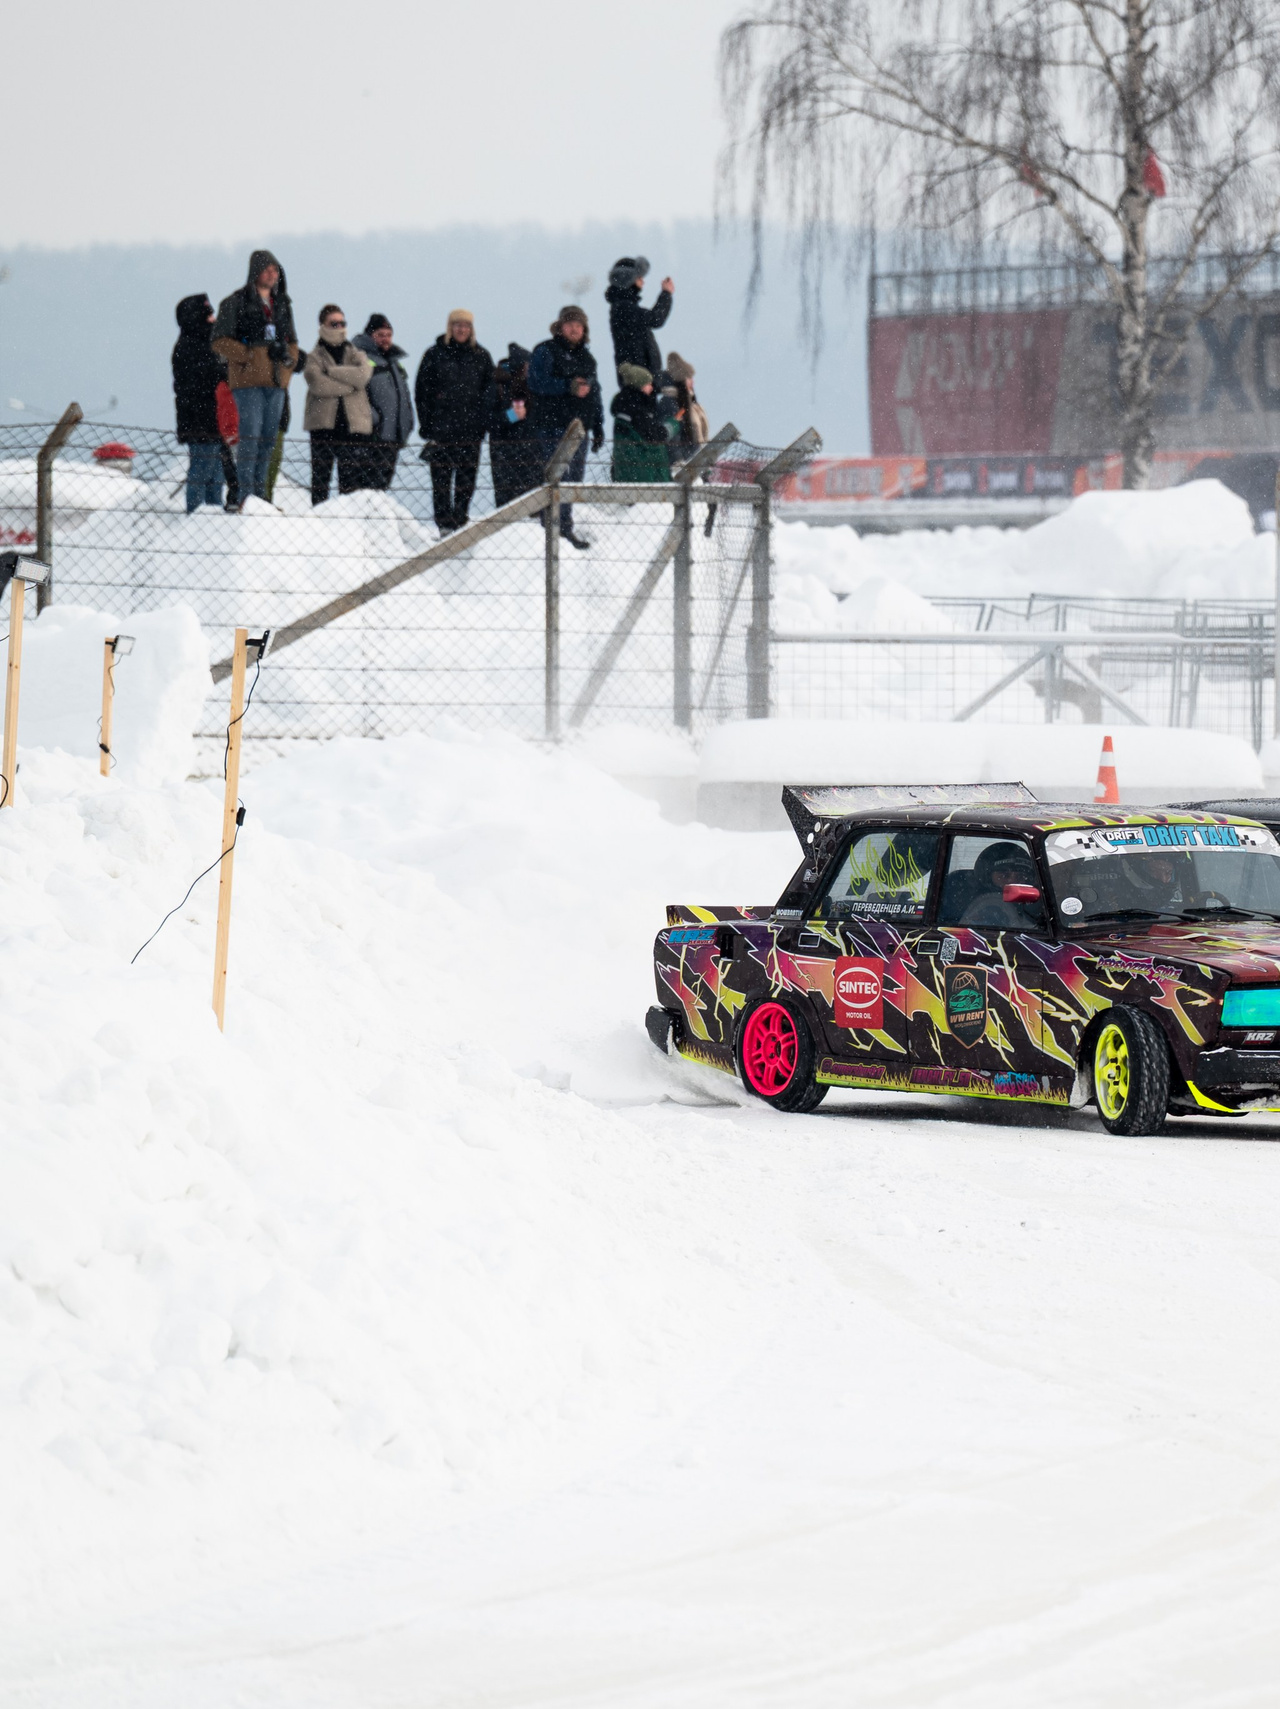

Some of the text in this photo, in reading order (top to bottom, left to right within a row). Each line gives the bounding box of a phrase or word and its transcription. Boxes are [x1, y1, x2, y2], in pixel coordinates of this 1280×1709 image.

[1106, 831, 1140, 841] DRIFT
[1143, 826, 1241, 847] DRIFT TAXI
[852, 902, 901, 914] ПЕРЕВЕДЕНЦЕВ
[839, 981, 878, 995] SINTEC
[950, 1011, 985, 1025] WW RENT
